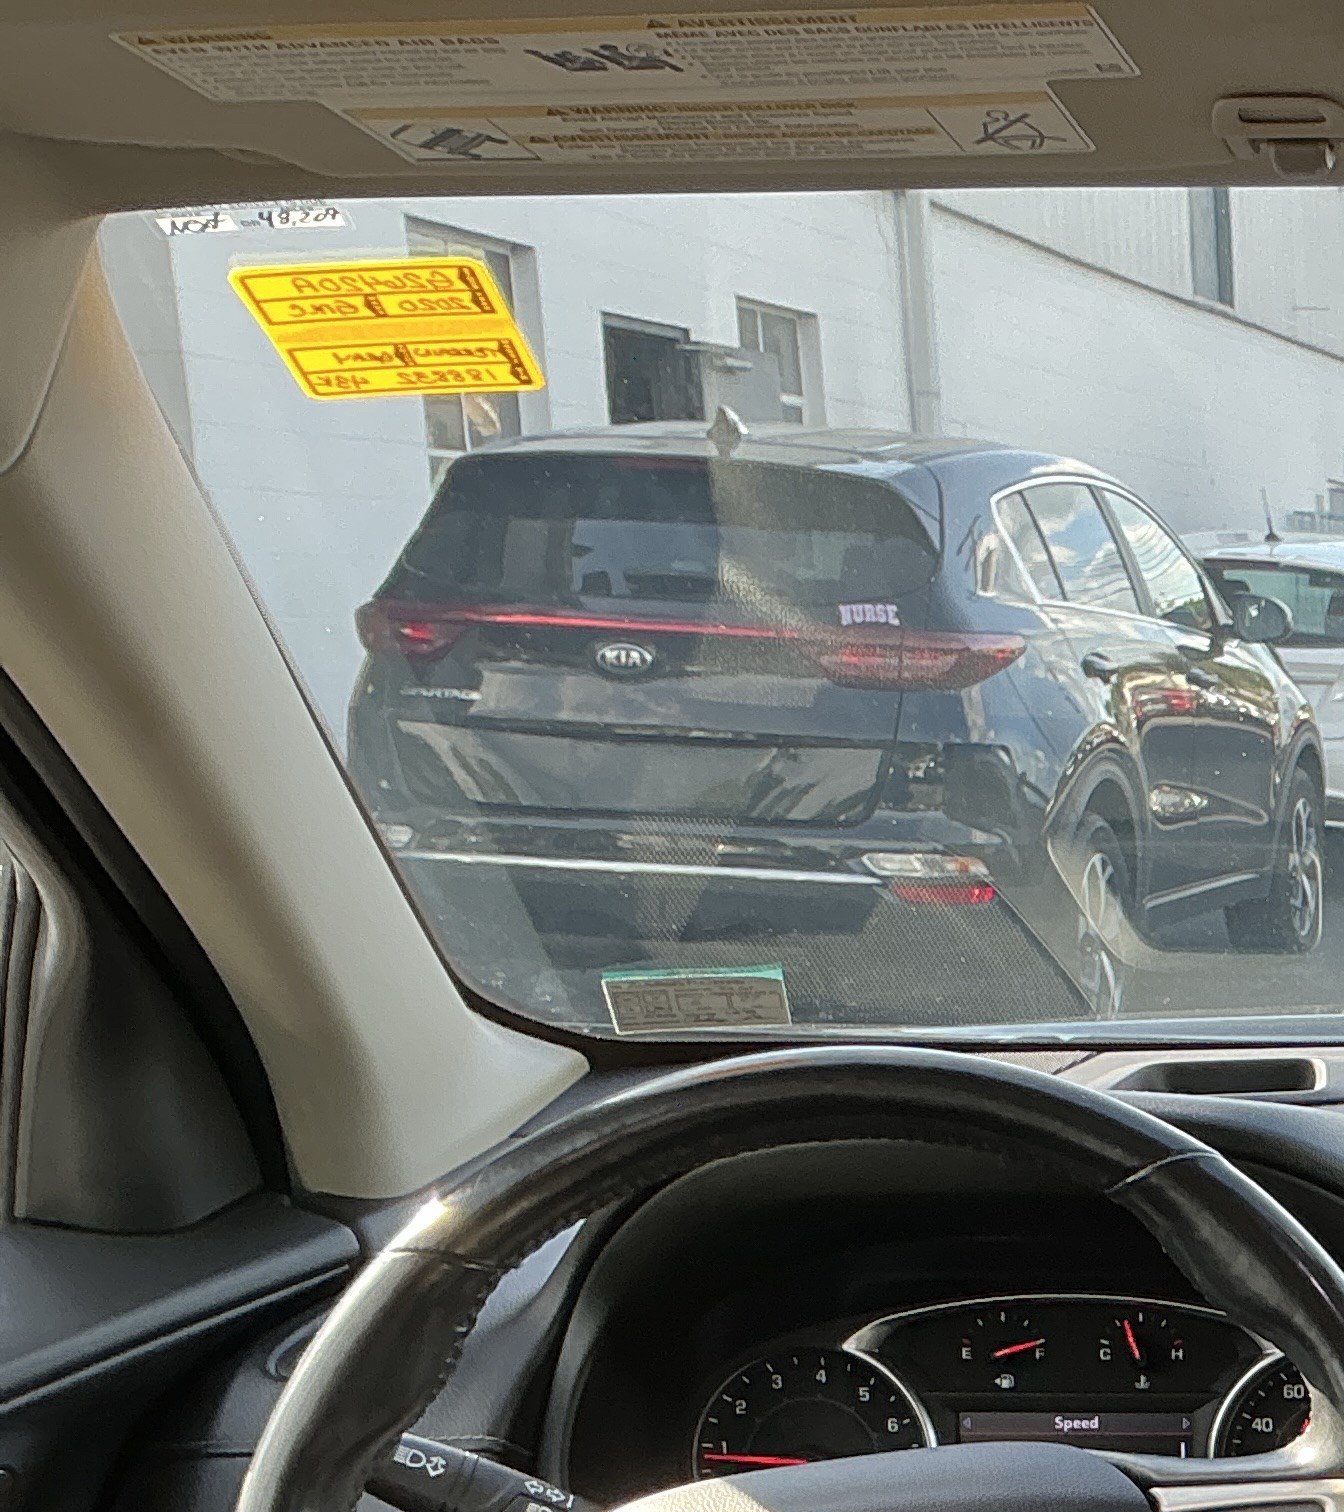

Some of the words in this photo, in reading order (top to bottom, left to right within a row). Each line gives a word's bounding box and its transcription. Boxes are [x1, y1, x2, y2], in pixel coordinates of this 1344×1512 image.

[399, 37, 435, 47] AIR
[837, 602, 900, 628] NURSE
[604, 646, 646, 669] KIA
[961, 1347, 973, 1360] E
[1034, 1347, 1046, 1361] F
[1170, 1347, 1184, 1361] H
[771, 1373, 783, 1390] 3
[815, 1367, 828, 1384] 4
[858, 1386, 870, 1402] 5
[1282, 1383, 1305, 1400] 60
[735, 1399, 747, 1415] 2
[887, 1417, 899, 1433] 6
[1053, 1415, 1100, 1432] Speed
[1251, 1417, 1274, 1433] 40
